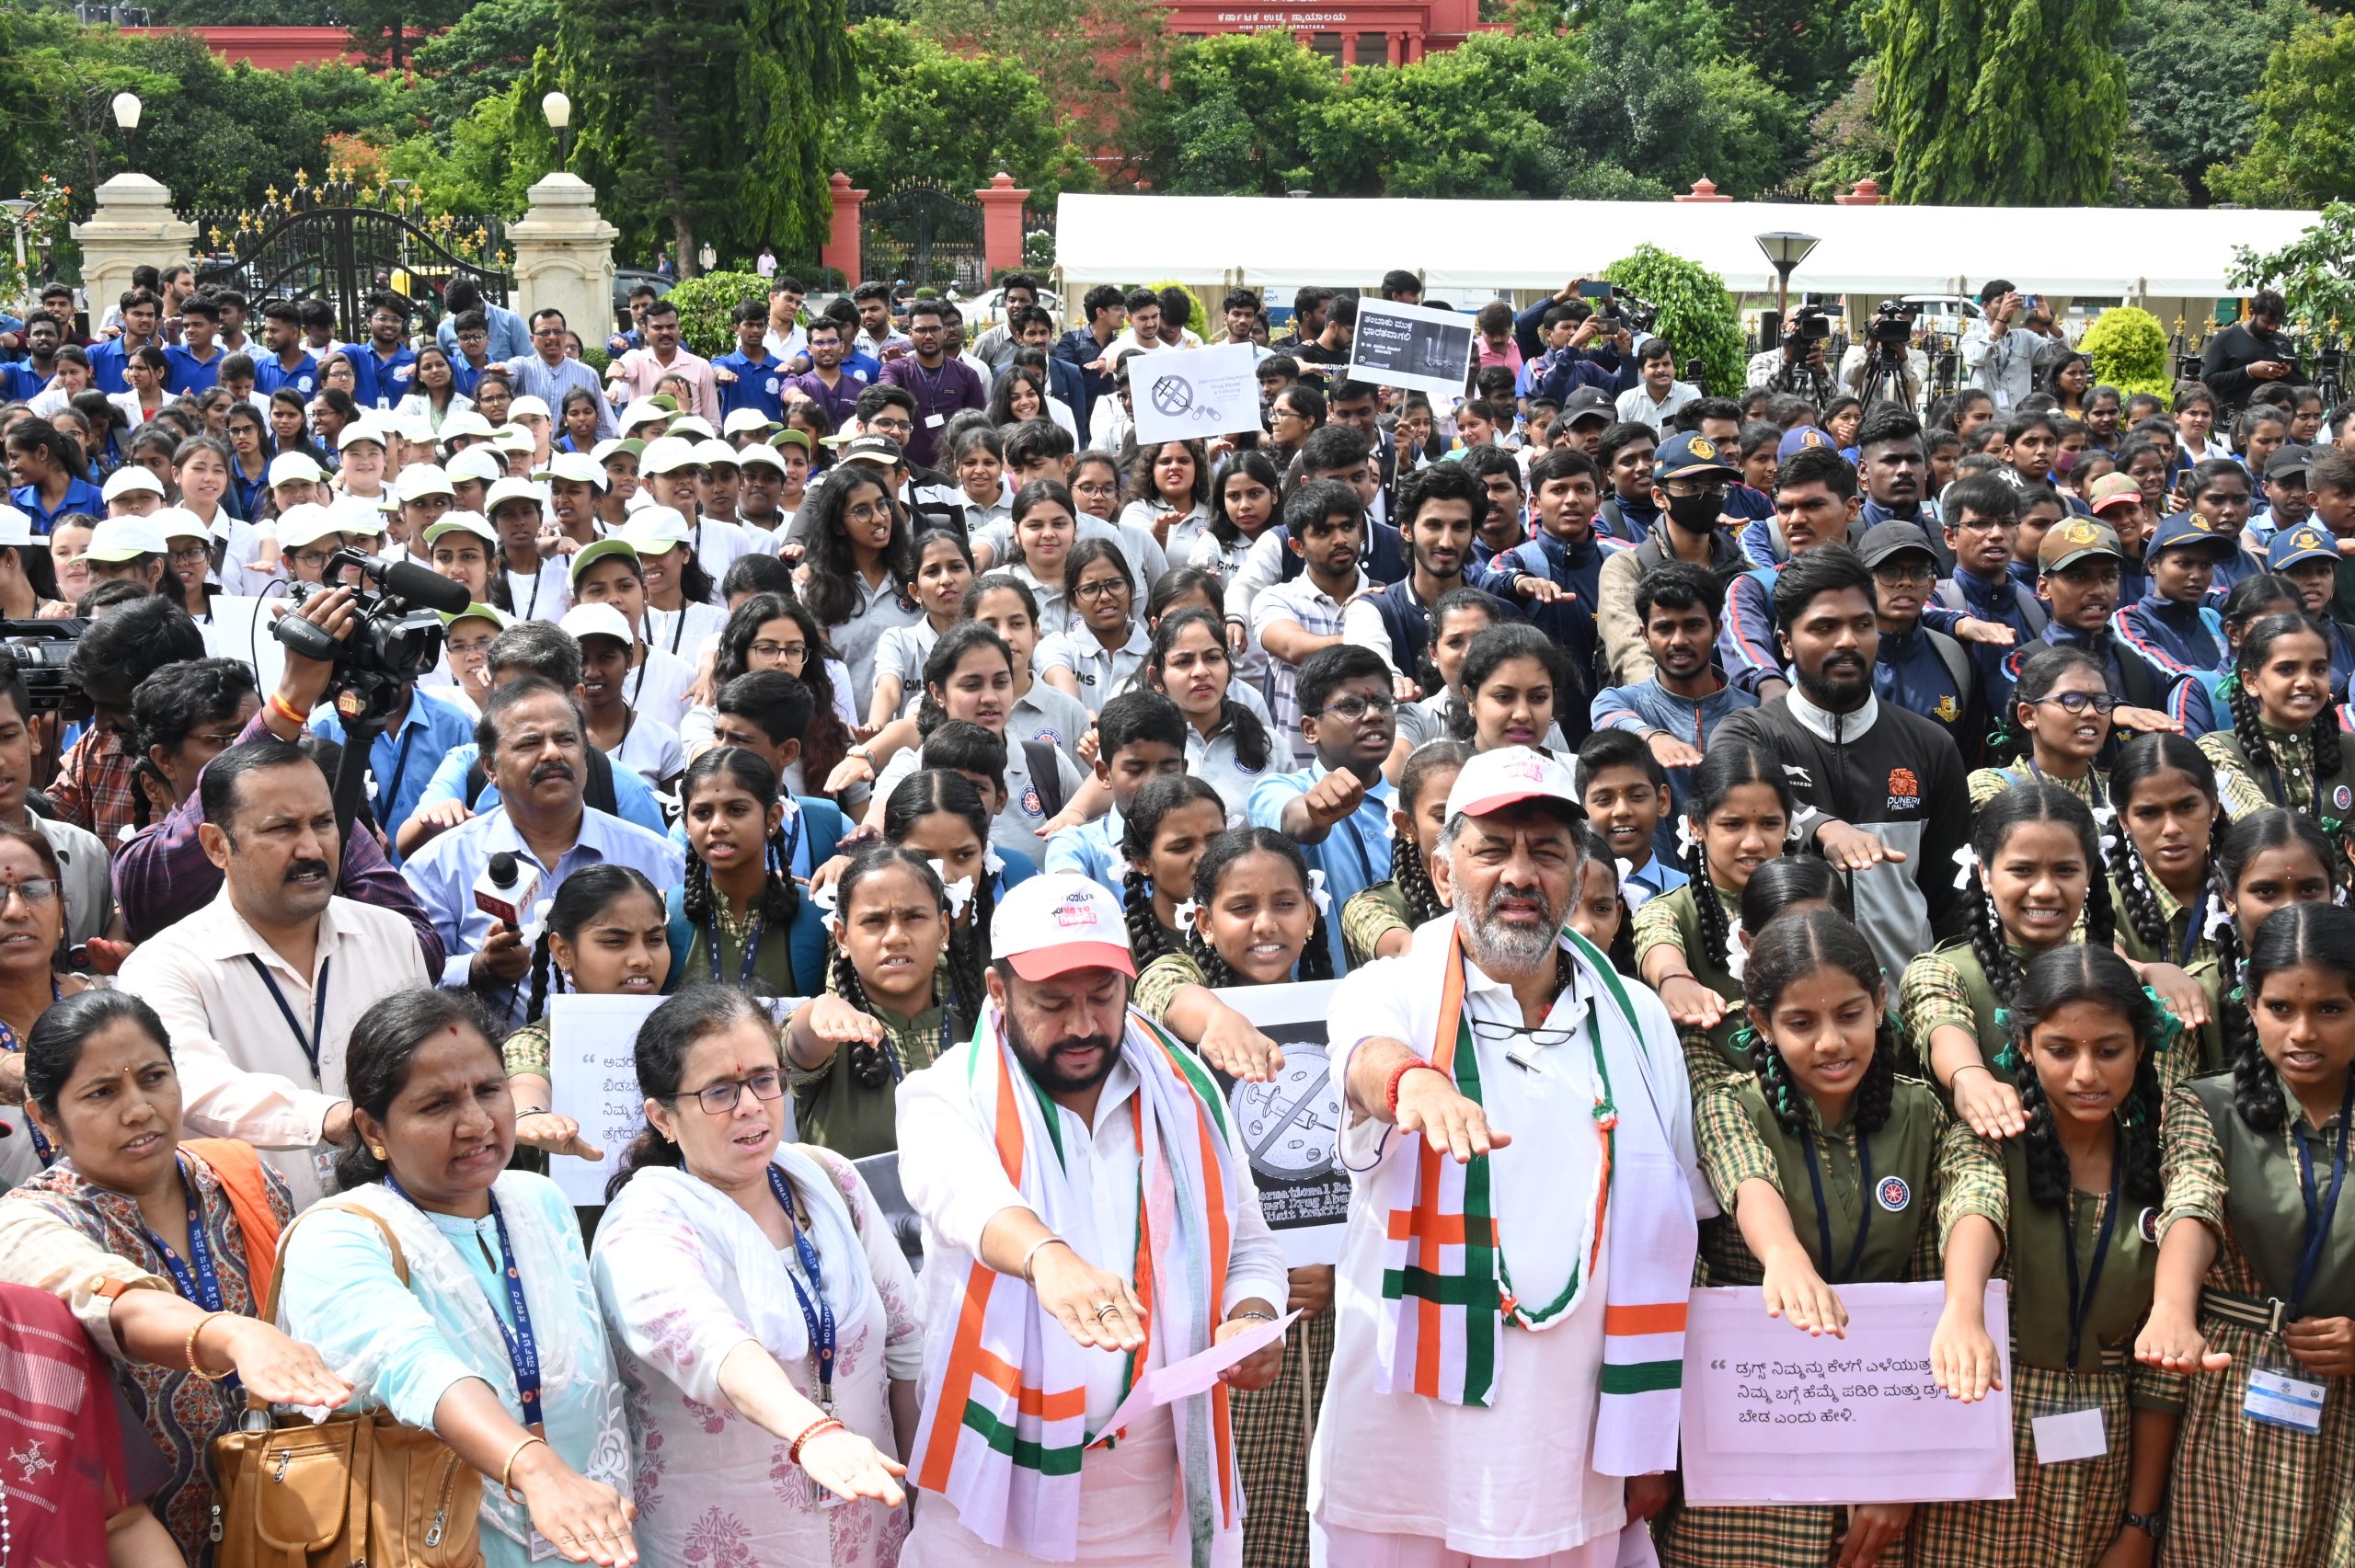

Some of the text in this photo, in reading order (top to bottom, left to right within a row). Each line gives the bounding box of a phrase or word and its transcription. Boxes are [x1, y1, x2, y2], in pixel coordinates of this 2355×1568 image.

[290, 626, 315, 641] SONY
[1074, 671, 1096, 686] MS
[1887, 796, 1920, 808] PUNERI
[1288, 1197, 1320, 1209] Drug
[1827, 1358, 1863, 1373] ಕೆಳಗೆ
[1737, 1384, 1773, 1404] ನಿಮ್ಮ
[1738, 1409, 1770, 1424] ಬೇಡ
[1775, 1411, 1817, 1424] ಎಂದು
